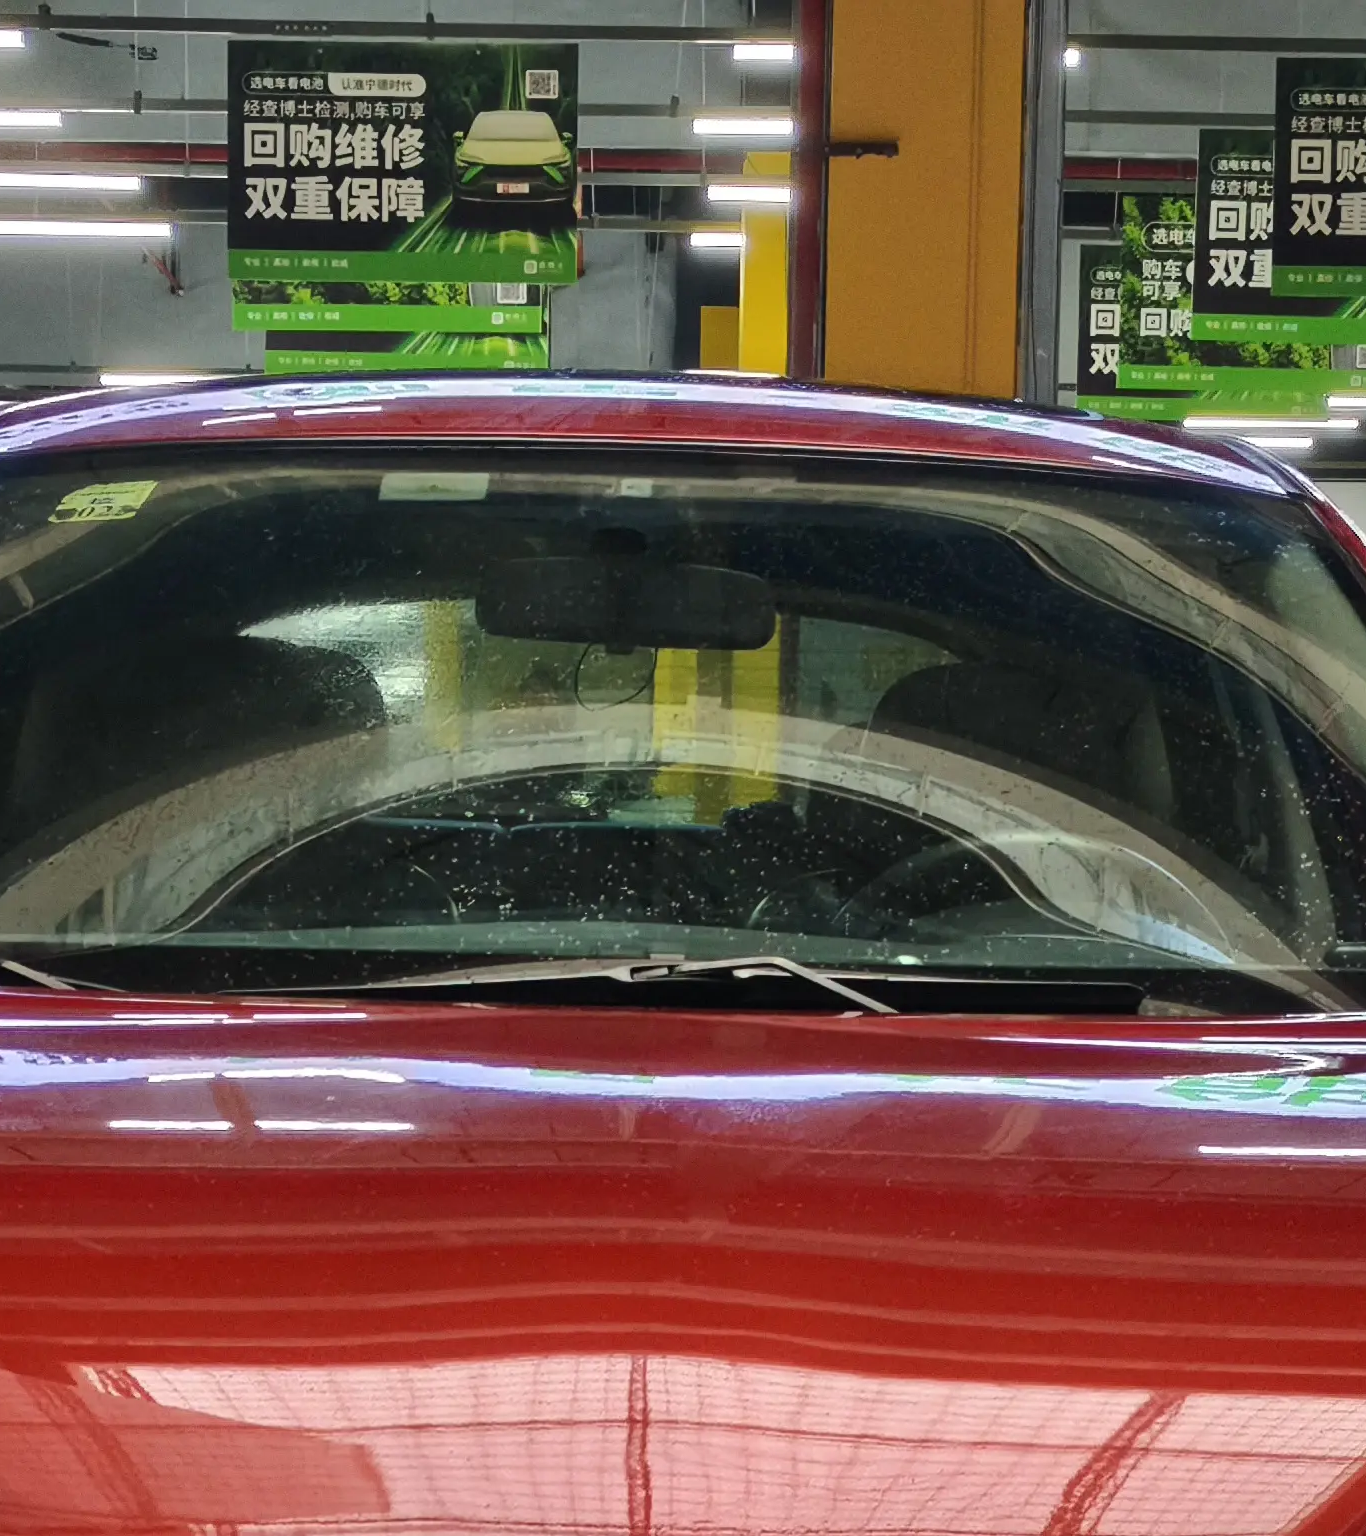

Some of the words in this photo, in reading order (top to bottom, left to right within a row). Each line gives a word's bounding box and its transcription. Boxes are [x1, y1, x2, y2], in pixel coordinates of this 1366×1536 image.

[250, 77, 323, 91] 选电车看电池
[342, 78, 414, 92] 认准宁德时代
[244, 101, 425, 120] 经查博士检测,购车可享
[244, 123, 425, 169] 回购维修
[245, 177, 425, 223] 双重保障
[1142, 259, 1182, 279] 购车
[1142, 281, 1181, 300] 可享
